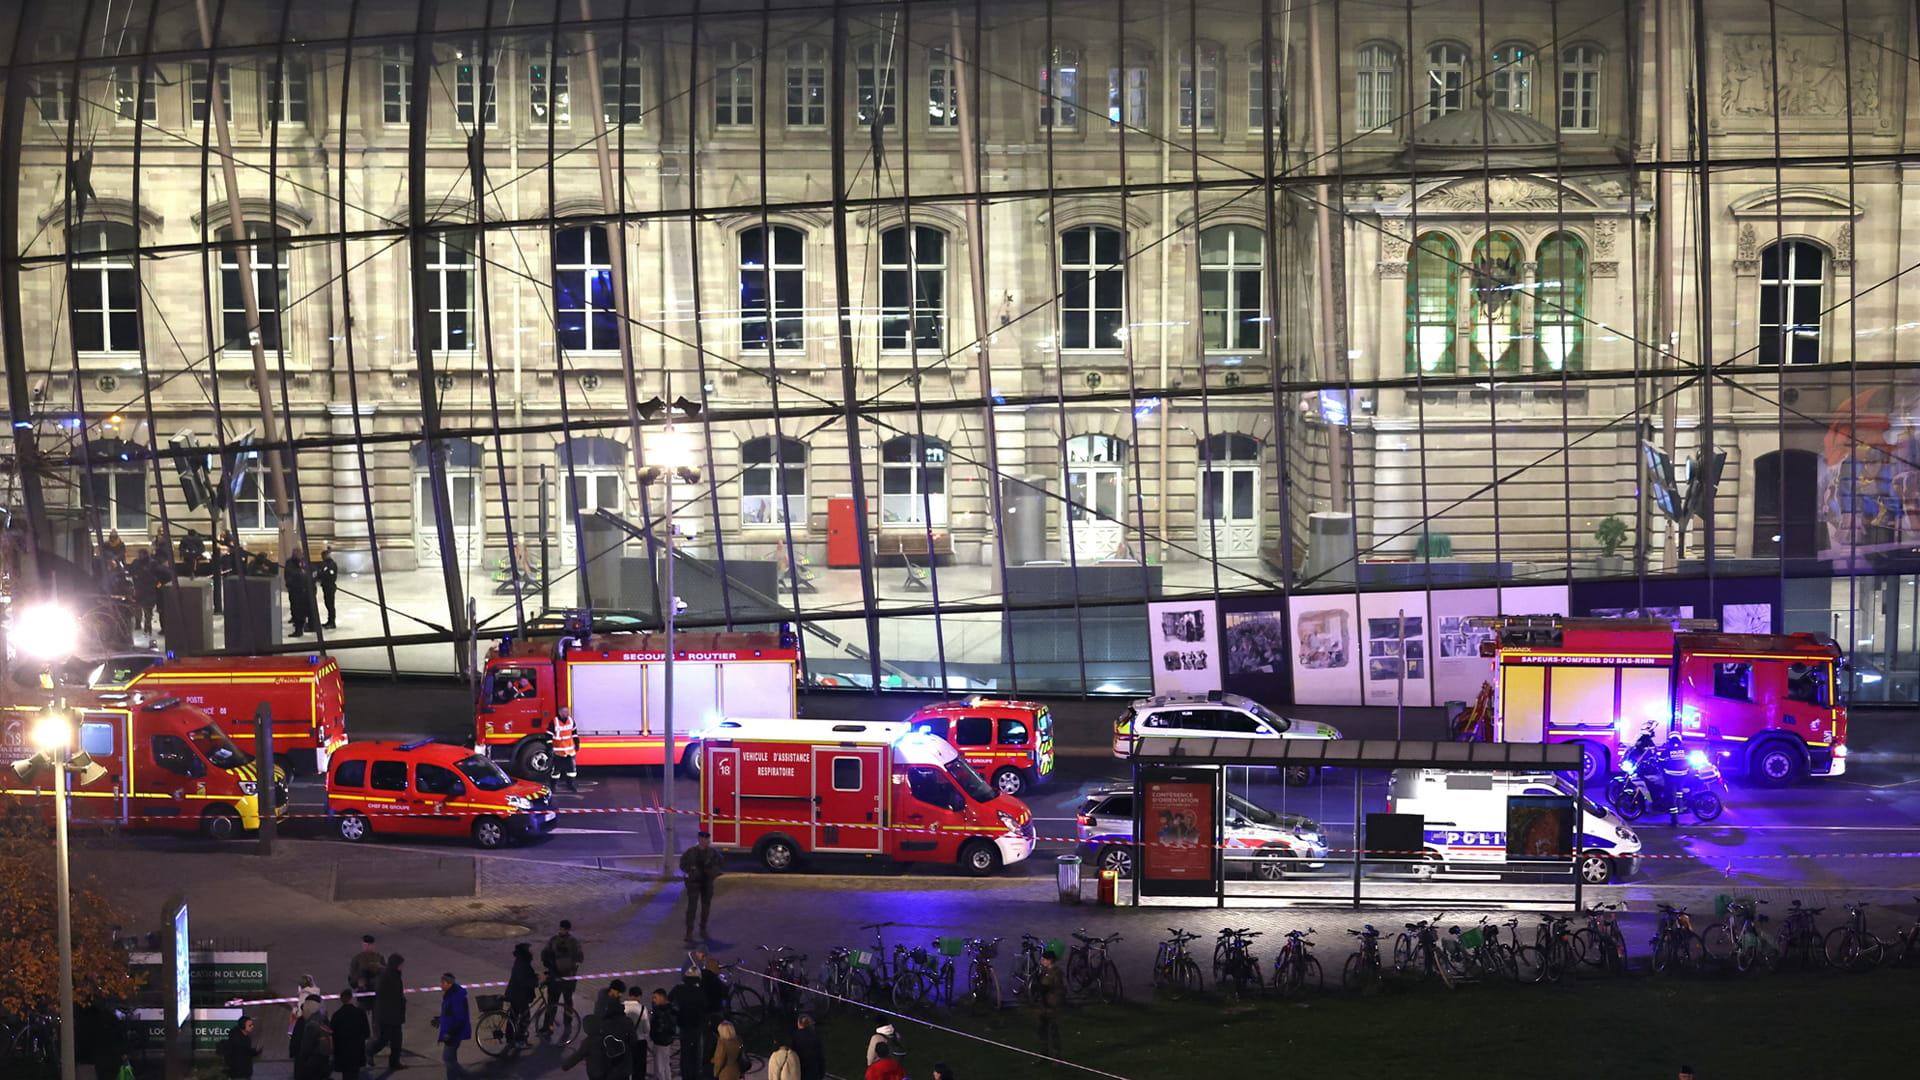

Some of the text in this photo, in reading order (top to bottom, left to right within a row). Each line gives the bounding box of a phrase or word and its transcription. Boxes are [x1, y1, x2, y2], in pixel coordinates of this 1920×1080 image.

[688, 652, 737, 660] ROUTIER
[1521, 656, 1601, 664] SAPEURS-POMPIERS
[186, 696, 204, 704] POSTE
[743, 752, 811, 763] VEHICULE D'ASSISTANCE
[719, 765, 731, 776] 18
[757, 766, 795, 777] RESPIRATOIRE
[1448, 832, 1506, 845] POLI
[223, 970, 233, 978] DE
[235, 969, 263, 978] VÉLOS
[195, 1026, 231, 1036] DE VÉLO
